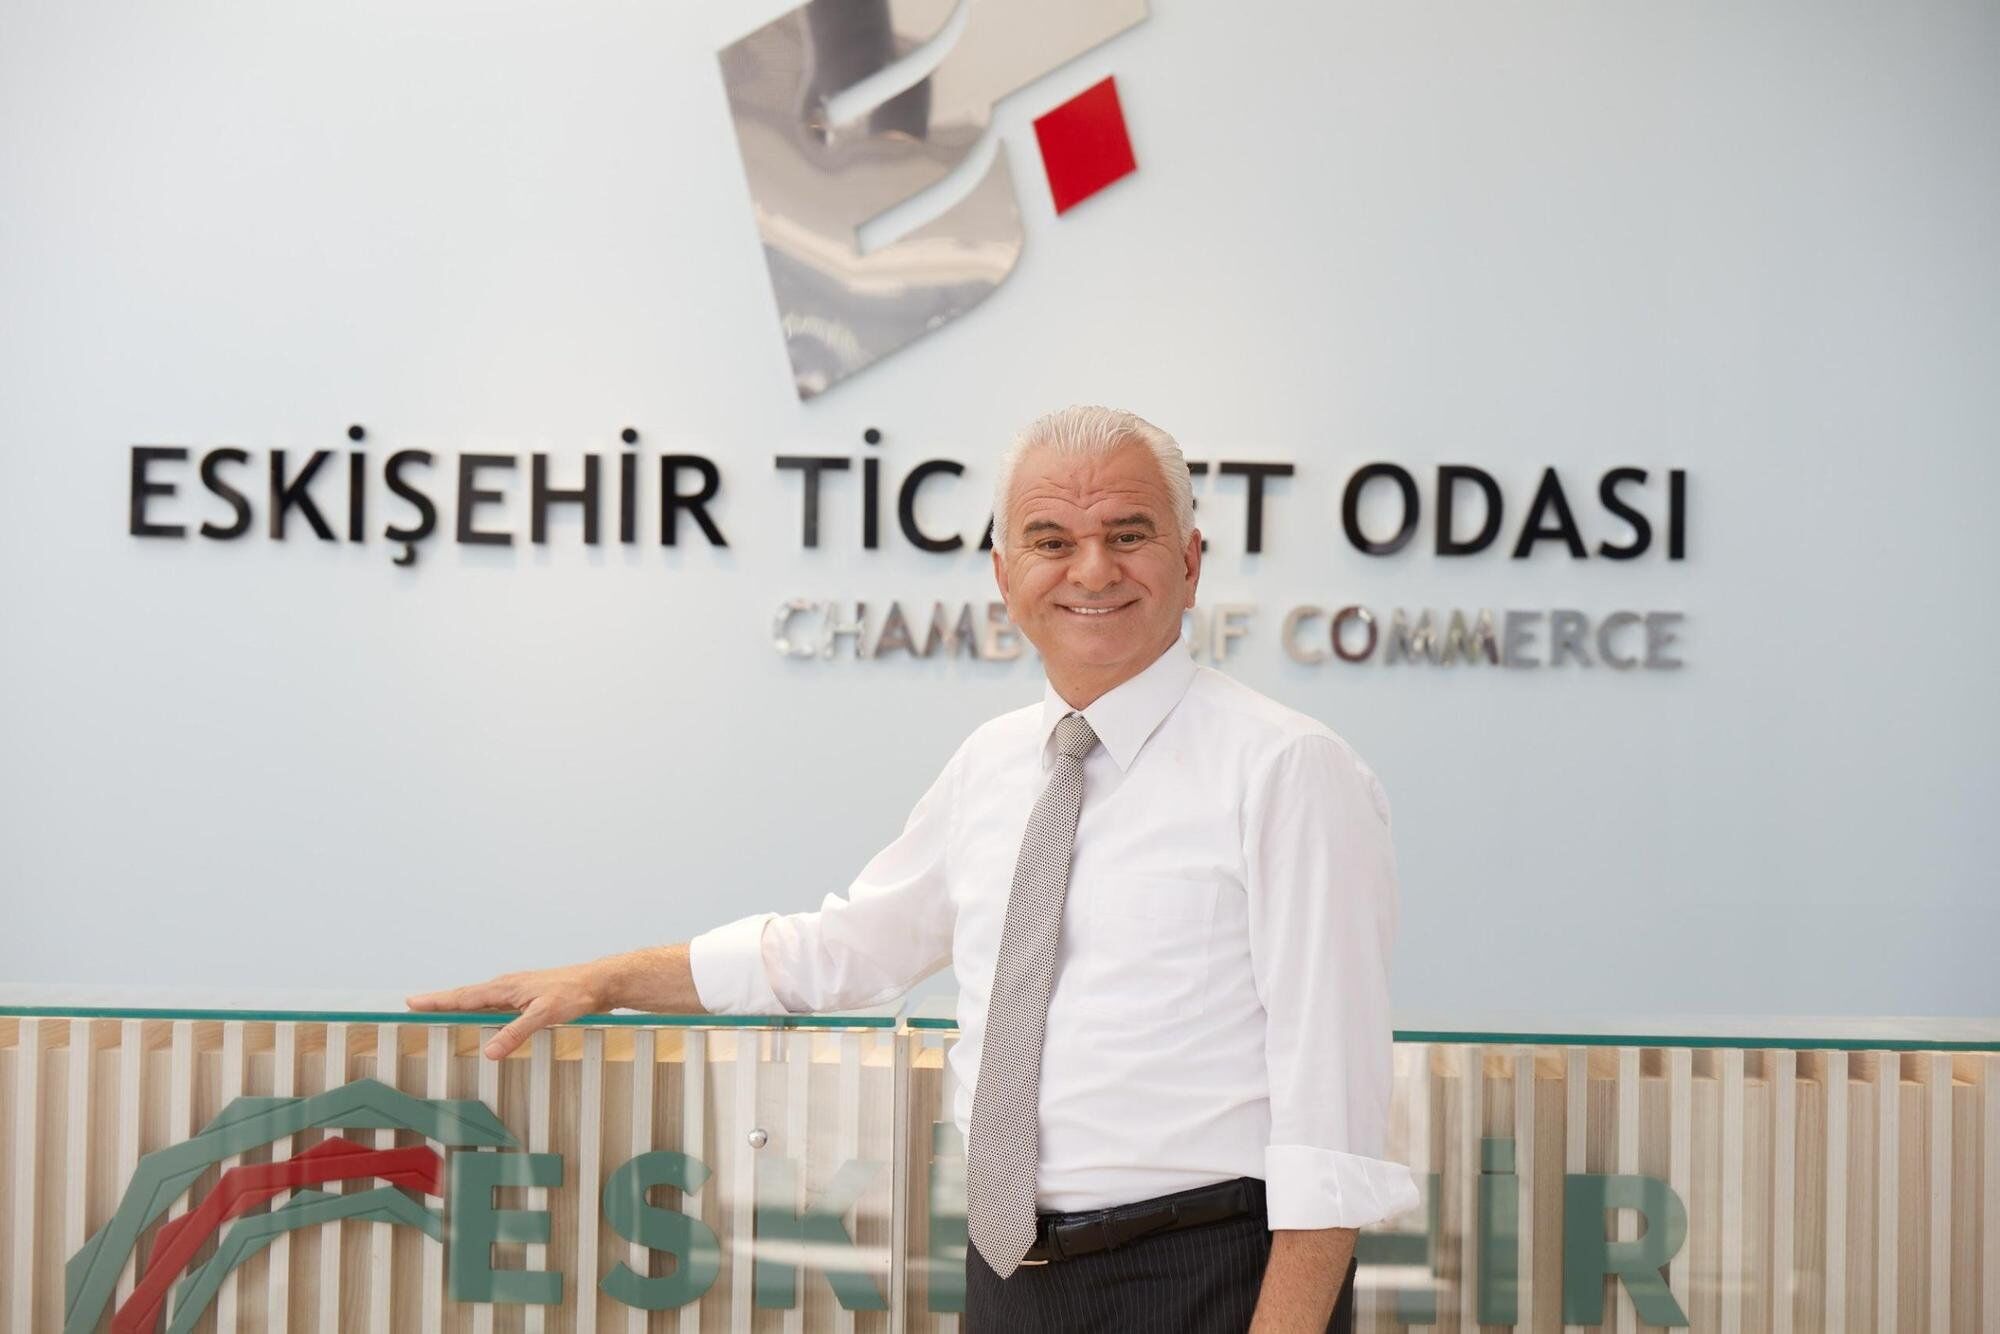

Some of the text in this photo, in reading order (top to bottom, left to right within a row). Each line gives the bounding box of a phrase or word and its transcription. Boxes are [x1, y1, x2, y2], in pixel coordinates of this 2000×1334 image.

[129, 424, 1687, 566] ESKİŞEHİR TİCT ODASI
[773, 597, 1045, 663] CHAMB
[1281, 604, 1686, 671] COMMERCE
[451, 1121, 1691, 1327] ESKİİR
